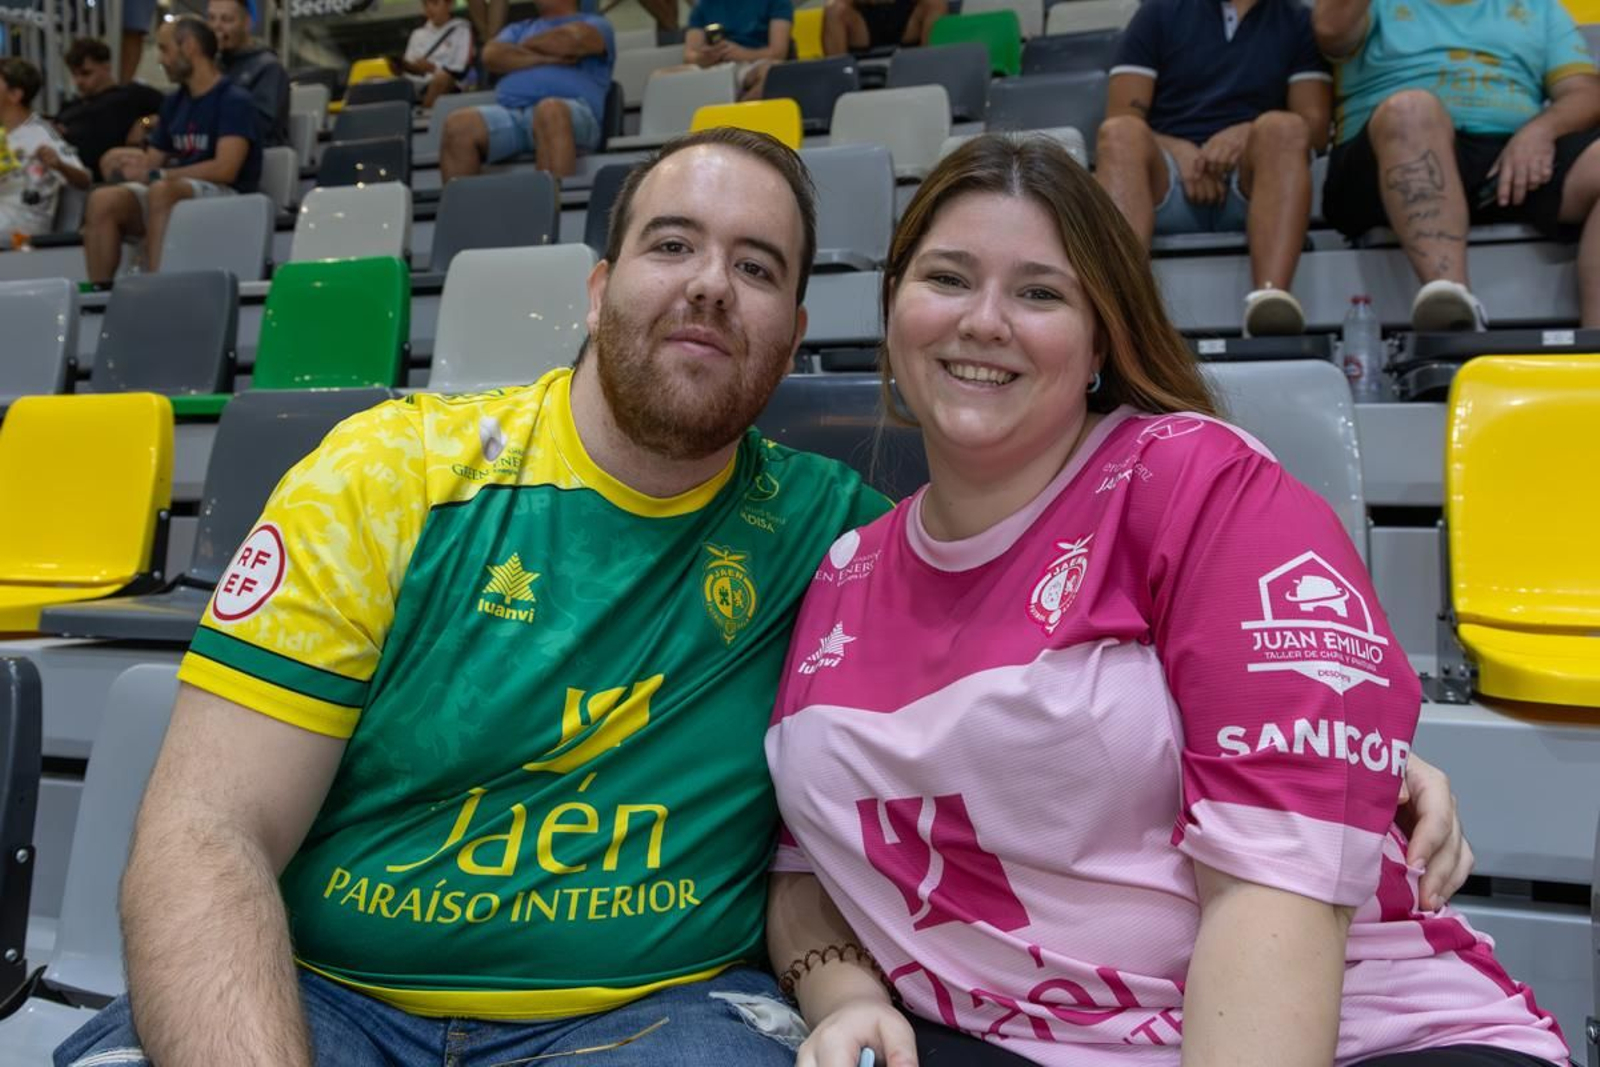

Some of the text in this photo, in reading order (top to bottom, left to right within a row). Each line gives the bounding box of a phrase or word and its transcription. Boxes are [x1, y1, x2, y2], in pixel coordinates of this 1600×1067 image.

[477, 598, 535, 623] luanvi
[1253, 631, 1383, 664] JUAN EMILIO
[1264, 651, 1302, 660] TALLER
[1304, 650, 1318, 659] DE
[797, 656, 842, 674] lunvi
[386, 772, 669, 876] Jaén
[323, 867, 702, 924] PARAÍSO INTERIOR
